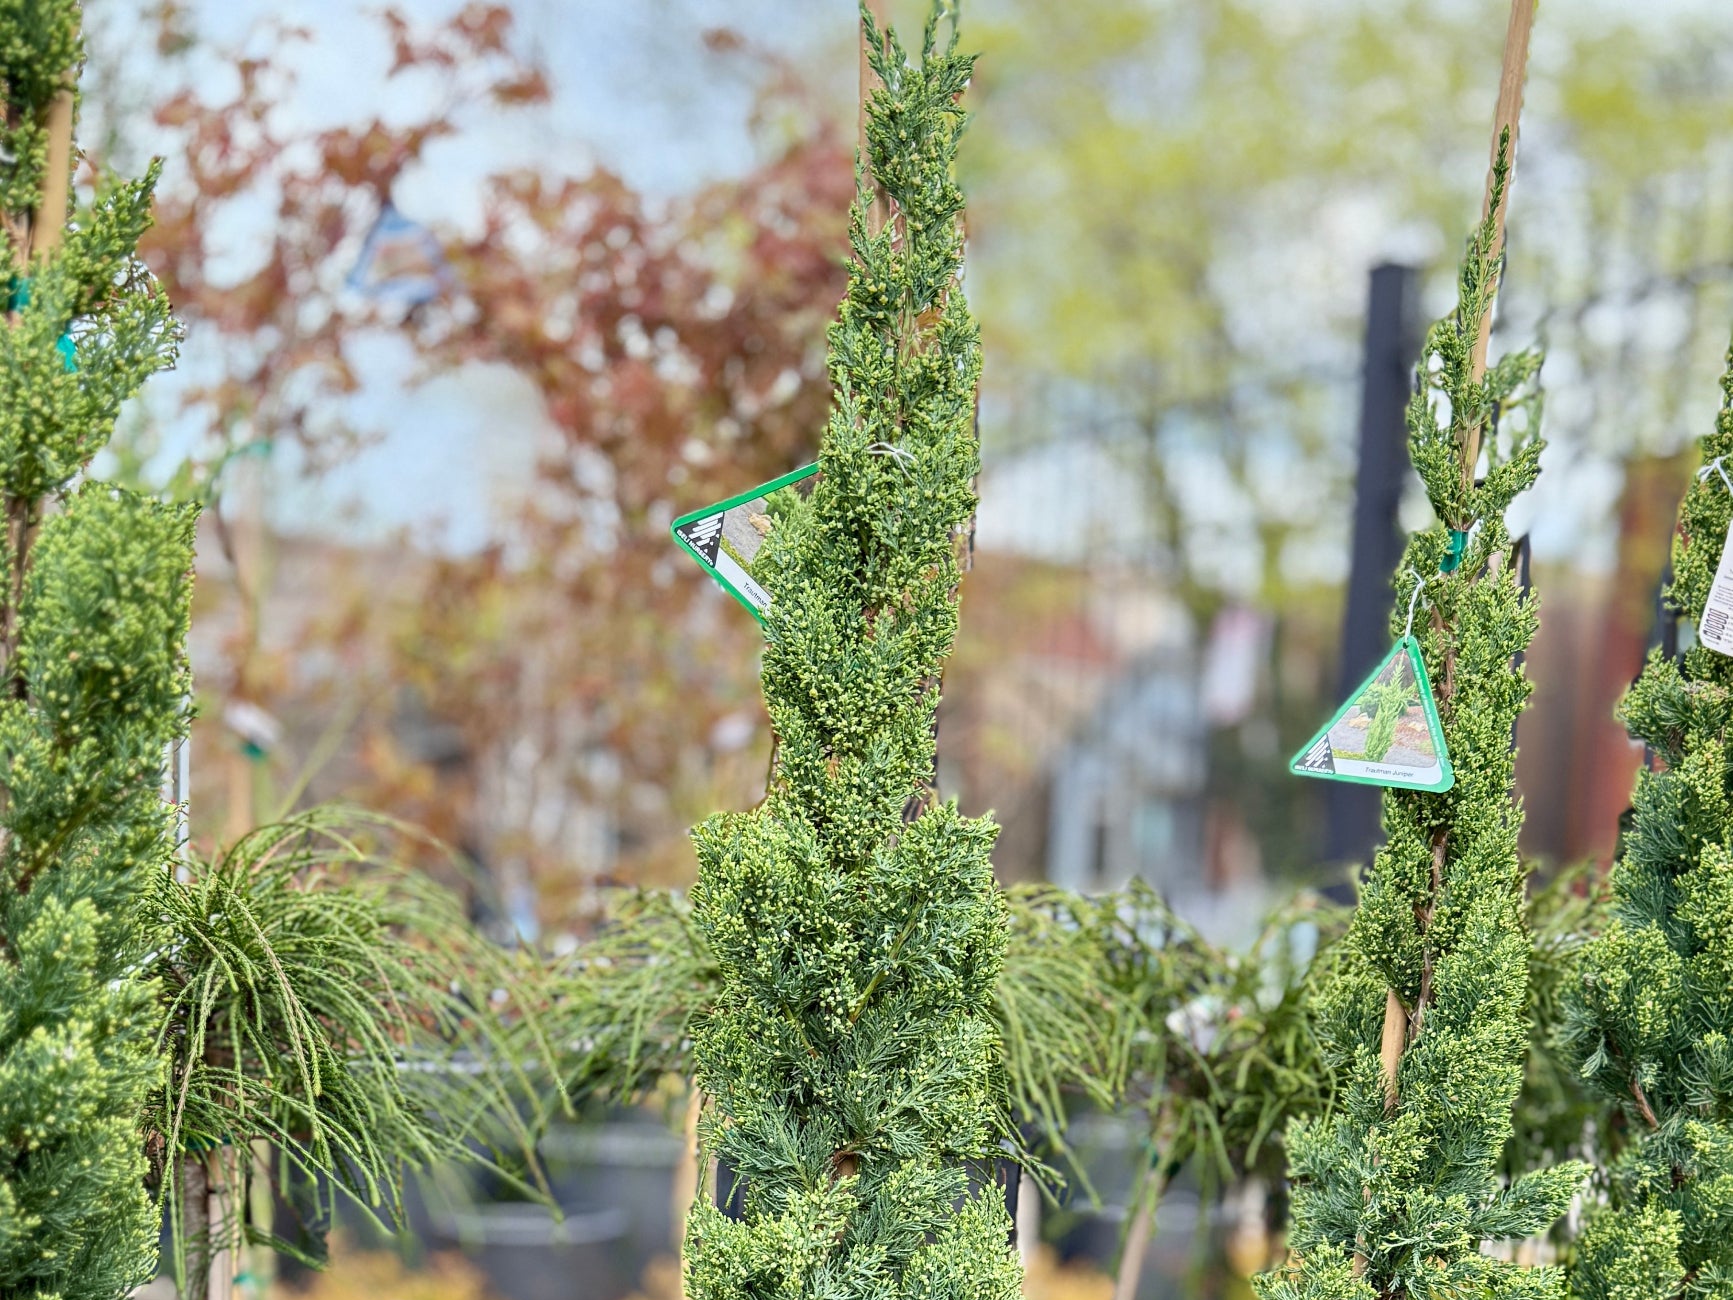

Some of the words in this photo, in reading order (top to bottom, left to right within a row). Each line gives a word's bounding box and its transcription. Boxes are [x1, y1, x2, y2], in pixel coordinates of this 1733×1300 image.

[743, 582, 768, 607] Trautman
[1365, 766, 1392, 775] Trautman
[1392, 769, 1414, 778] Juniper
